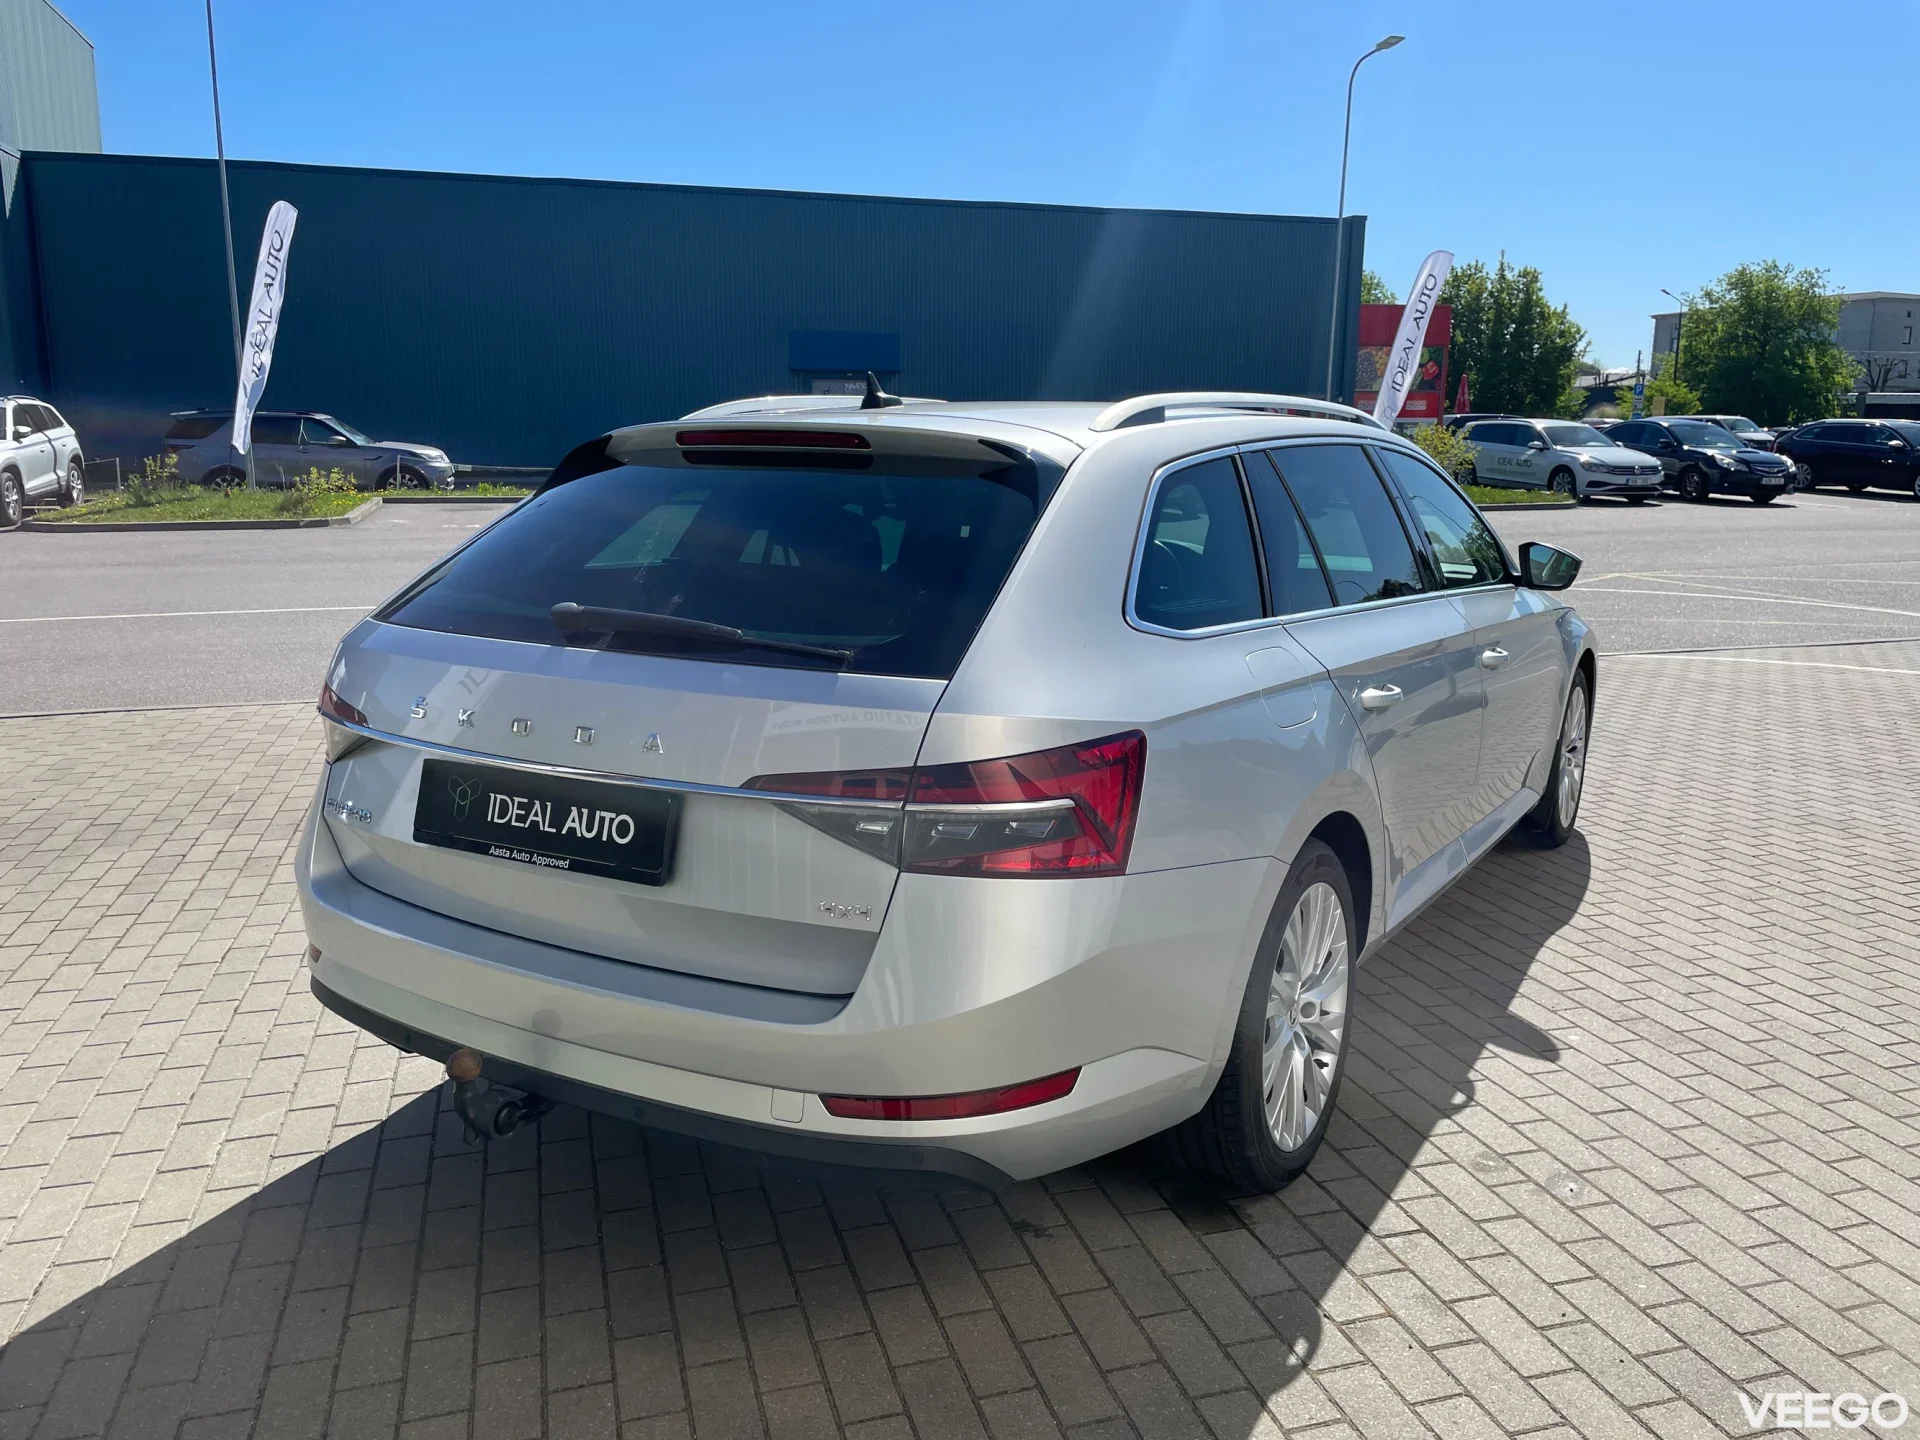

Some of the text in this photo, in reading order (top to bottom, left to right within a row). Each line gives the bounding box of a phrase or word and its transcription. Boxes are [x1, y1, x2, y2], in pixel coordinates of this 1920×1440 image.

[264, 229, 284, 302] AUTO
[1391, 335, 1418, 393] IDEAL
[1413, 273, 1437, 330] AUTO
[1497, 456, 1533, 468] IDEAL AUTO
[487, 792, 636, 845] IDEAL AUTO
[489, 845, 570, 869] Aasta Auto Approved
